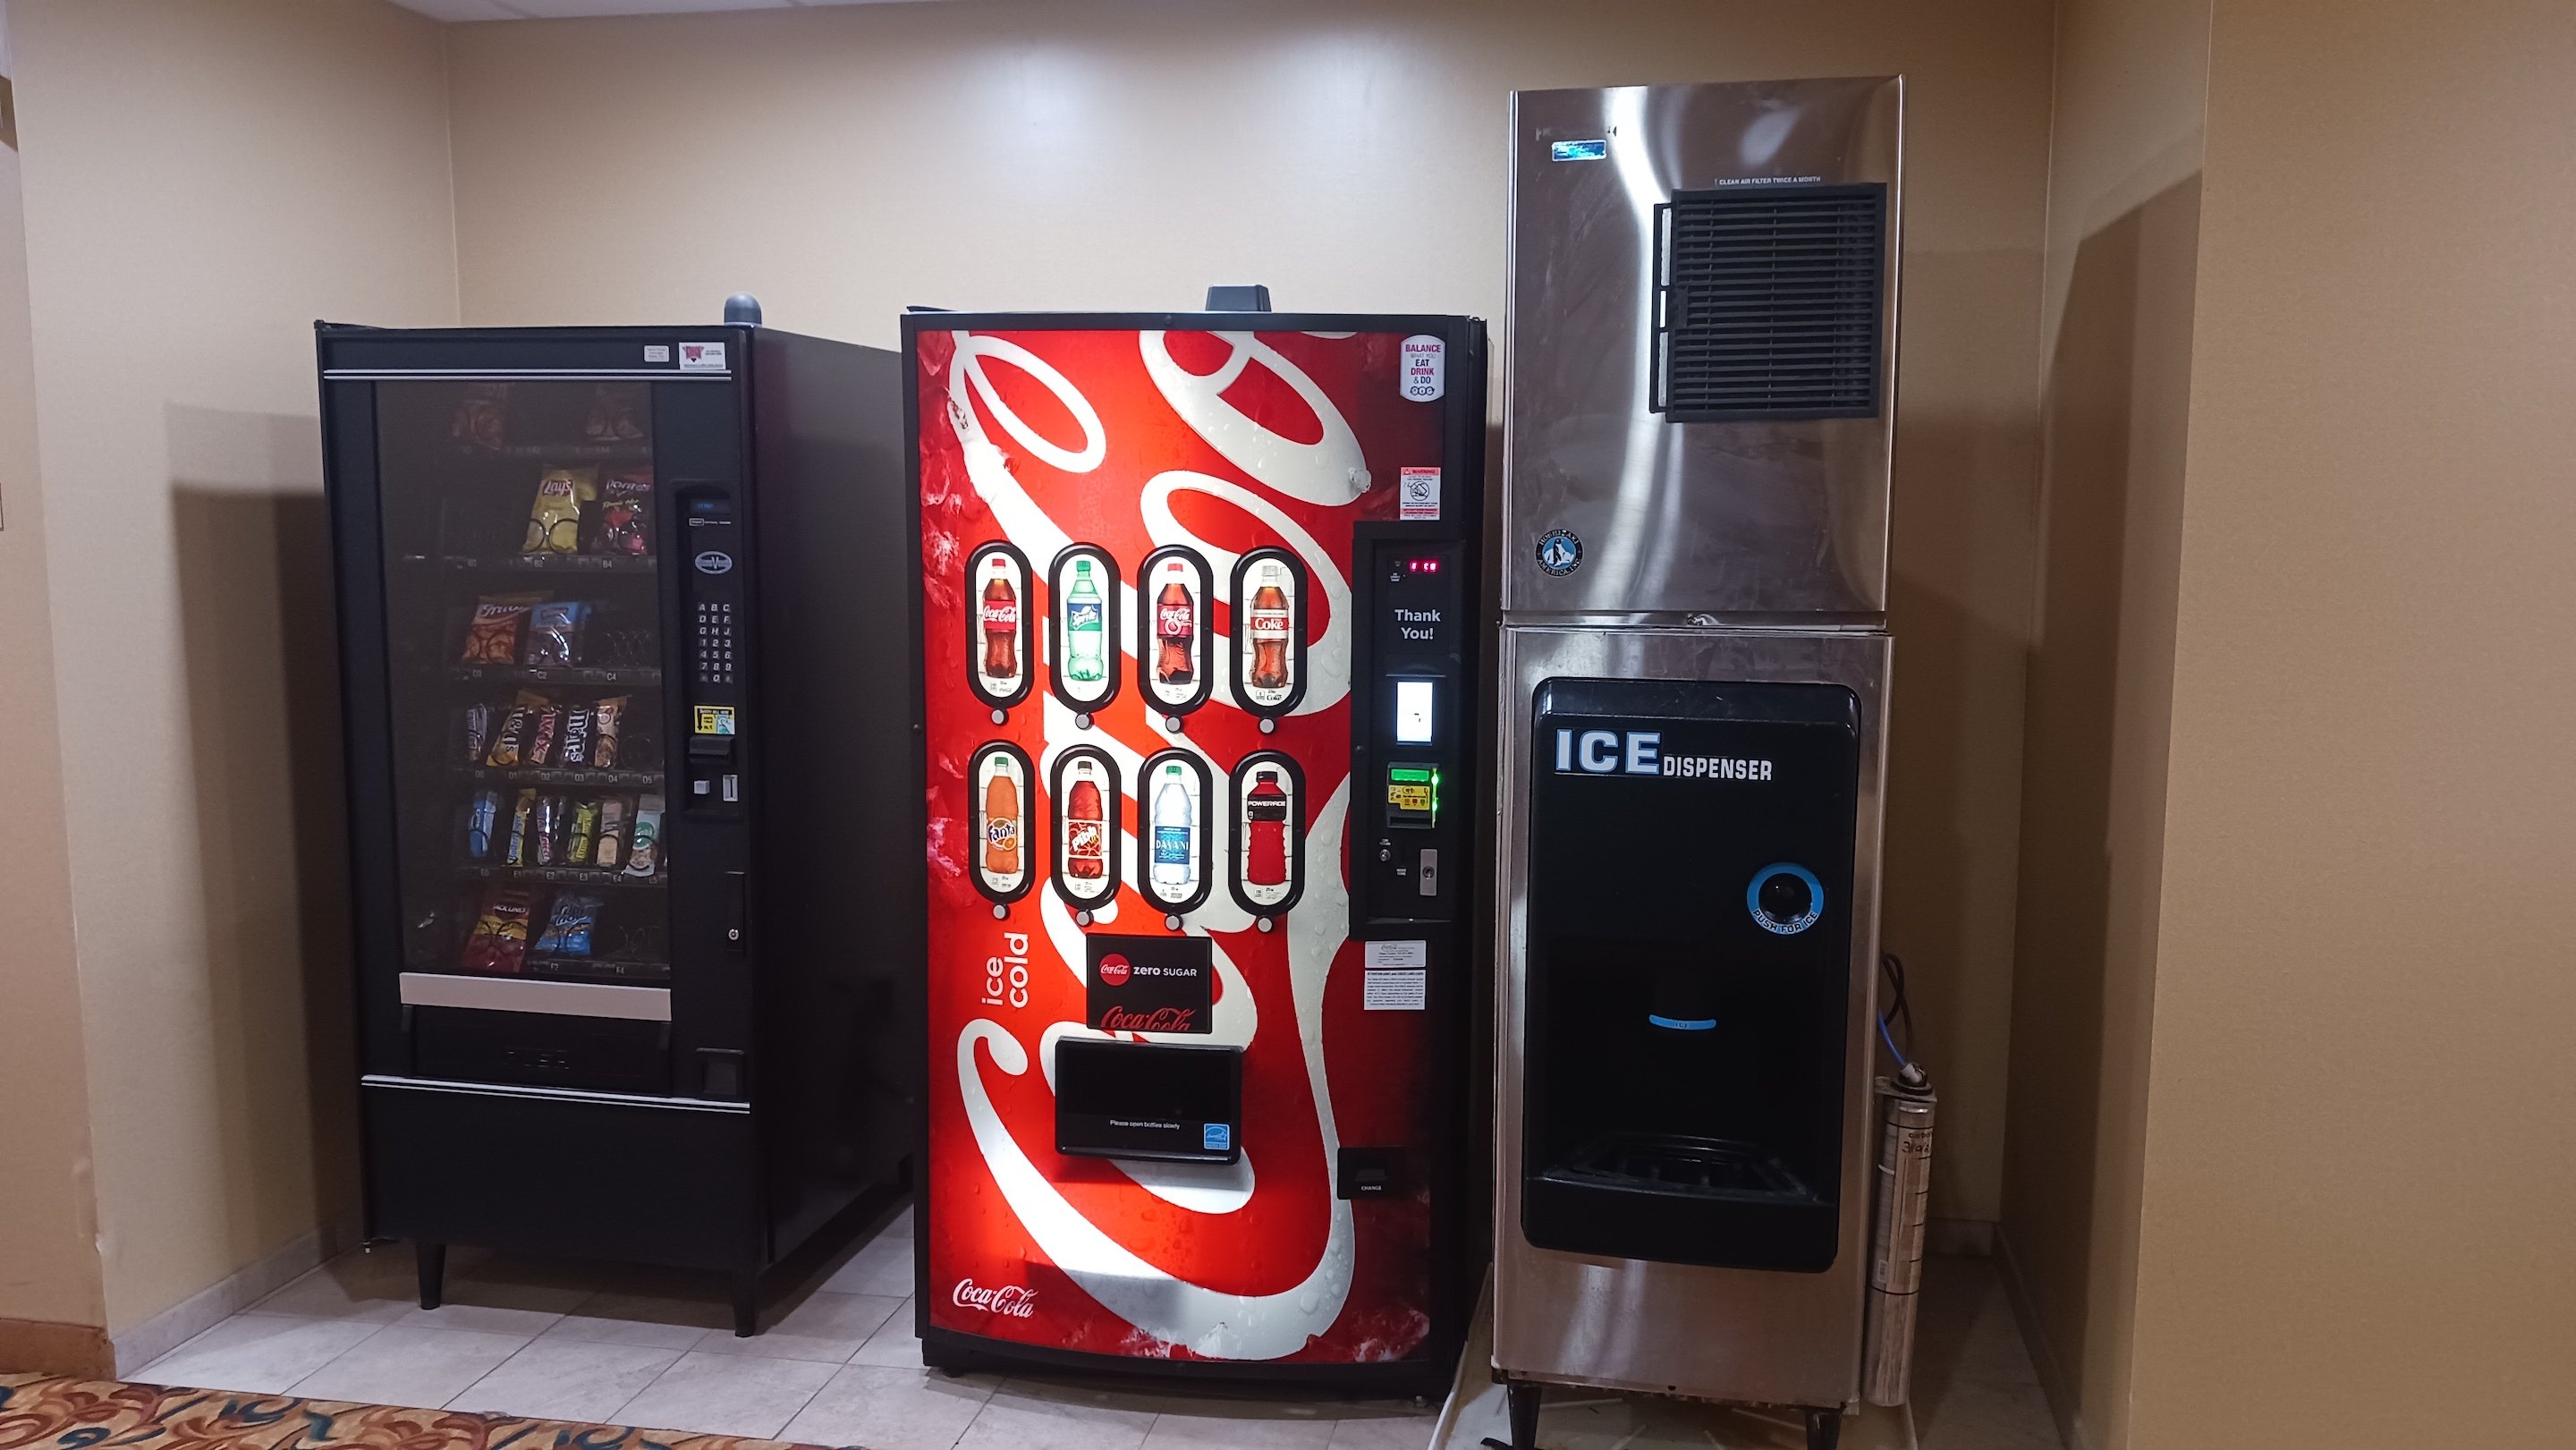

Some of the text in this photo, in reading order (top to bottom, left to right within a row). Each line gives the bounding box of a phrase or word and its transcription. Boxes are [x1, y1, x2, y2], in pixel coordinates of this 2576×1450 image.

[1405, 343, 1442, 352] BALANCE
[1415, 359, 1429, 367] EAT
[1411, 368, 1435, 376] DRINK
[1413, 376, 1431, 385] & DO
[602, 559, 613, 569] B4
[699, 603, 705, 611] A
[711, 603, 717, 611] B
[712, 615, 717, 623] E
[724, 615, 729, 623] F
[984, 605, 1016, 623] Coca-Cola
[1072, 609, 1098, 629] Sprite
[1160, 607, 1191, 621] Coca-Cola
[1394, 609, 1441, 622] Thank
[1254, 617, 1284, 630] Coke
[699, 627, 707, 635] G
[1401, 627, 1434, 640] You!
[724, 651, 731, 659] 6
[537, 671, 547, 680] C2
[606, 673, 617, 682] C4
[1555, 728, 1773, 781] ICE DISPENSER
[608, 774, 618, 784] D4
[642, 776, 653, 784] D5
[1156, 839, 1189, 851] DASANI
[546, 871, 555, 880] E2
[579, 873, 589, 882] E3
[1753, 909, 1818, 932] PUSH FOR ICE
[1004, 932, 1029, 1008] cold
[1100, 963, 1197, 977] Coca-Cola zero SUGAR
[982, 956, 1004, 1005] ice
[1100, 1005, 1195, 1030] Coca-Cola
[1144, 1121, 1163, 1129] bottles
[1163, 1123, 1181, 1131] slowly
[952, 1277, 1039, 1319] Coca-Cola
